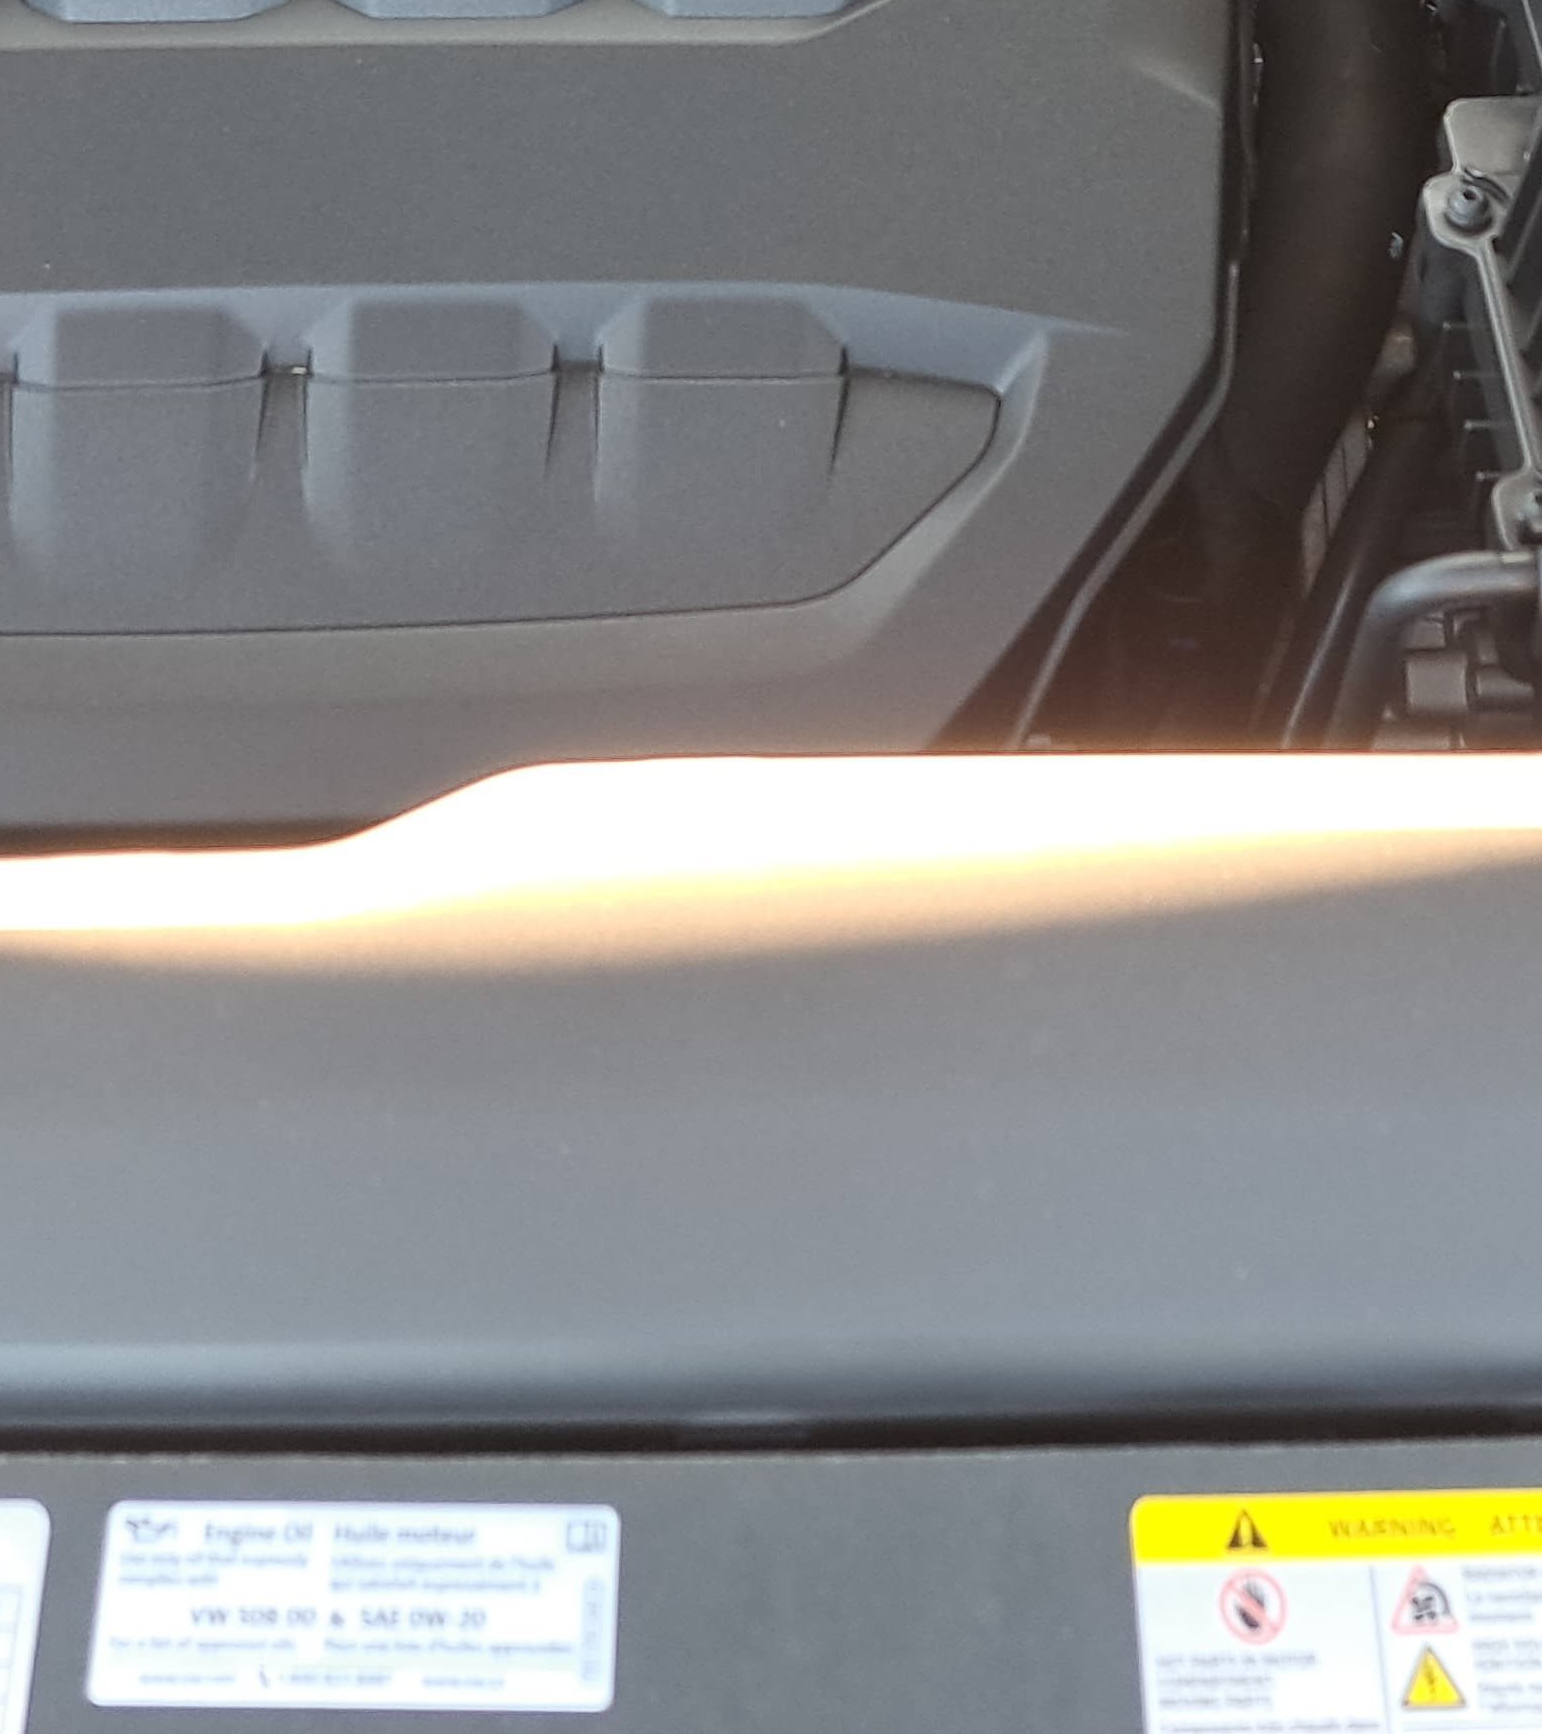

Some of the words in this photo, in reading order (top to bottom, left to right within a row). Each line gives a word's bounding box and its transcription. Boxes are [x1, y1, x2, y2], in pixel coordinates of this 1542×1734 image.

[205, 1522, 275, 1551] Engine
[335, 1521, 388, 1543] Huile
[397, 1524, 476, 1544] moteur
[1328, 1515, 1456, 1540] WARNING
[190, 1608, 228, 1627] VW
[287, 1607, 317, 1627] 00
[361, 1607, 399, 1628] SAE
